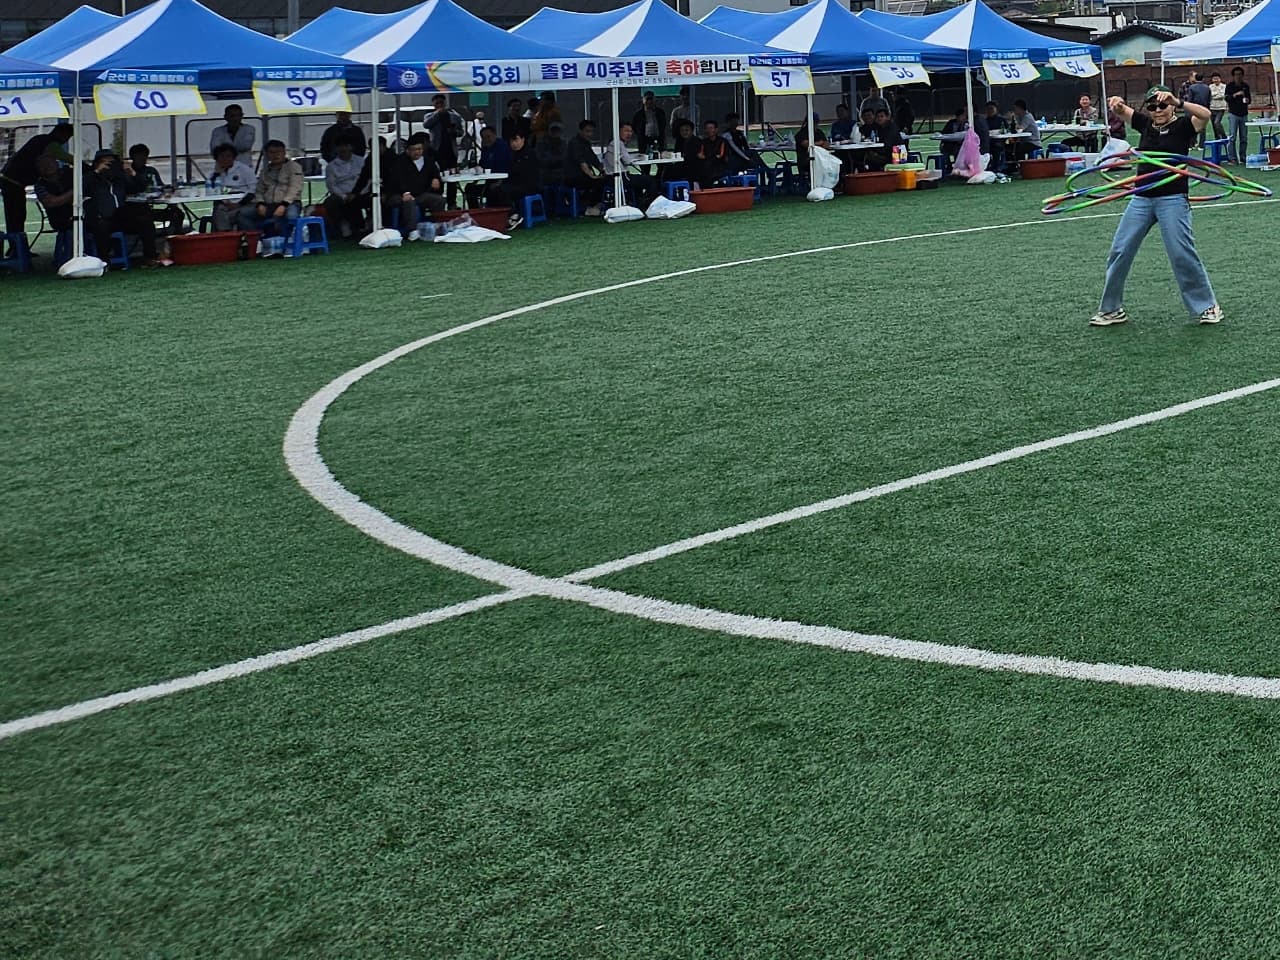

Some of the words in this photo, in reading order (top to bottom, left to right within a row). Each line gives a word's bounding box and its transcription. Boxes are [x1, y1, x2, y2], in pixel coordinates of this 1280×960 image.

[472, 64, 520, 87] 58회
[541, 62, 578, 80] 졸업
[585, 60, 660, 79] 40주년을
[665, 59, 746, 76] 축하합니다.
[890, 66, 914, 79] 56
[1000, 63, 1020, 78] 55
[1065, 60, 1086, 74] 54
[771, 71, 790, 87] 57
[133, 90, 168, 110] 60
[286, 86, 317, 106] 59
